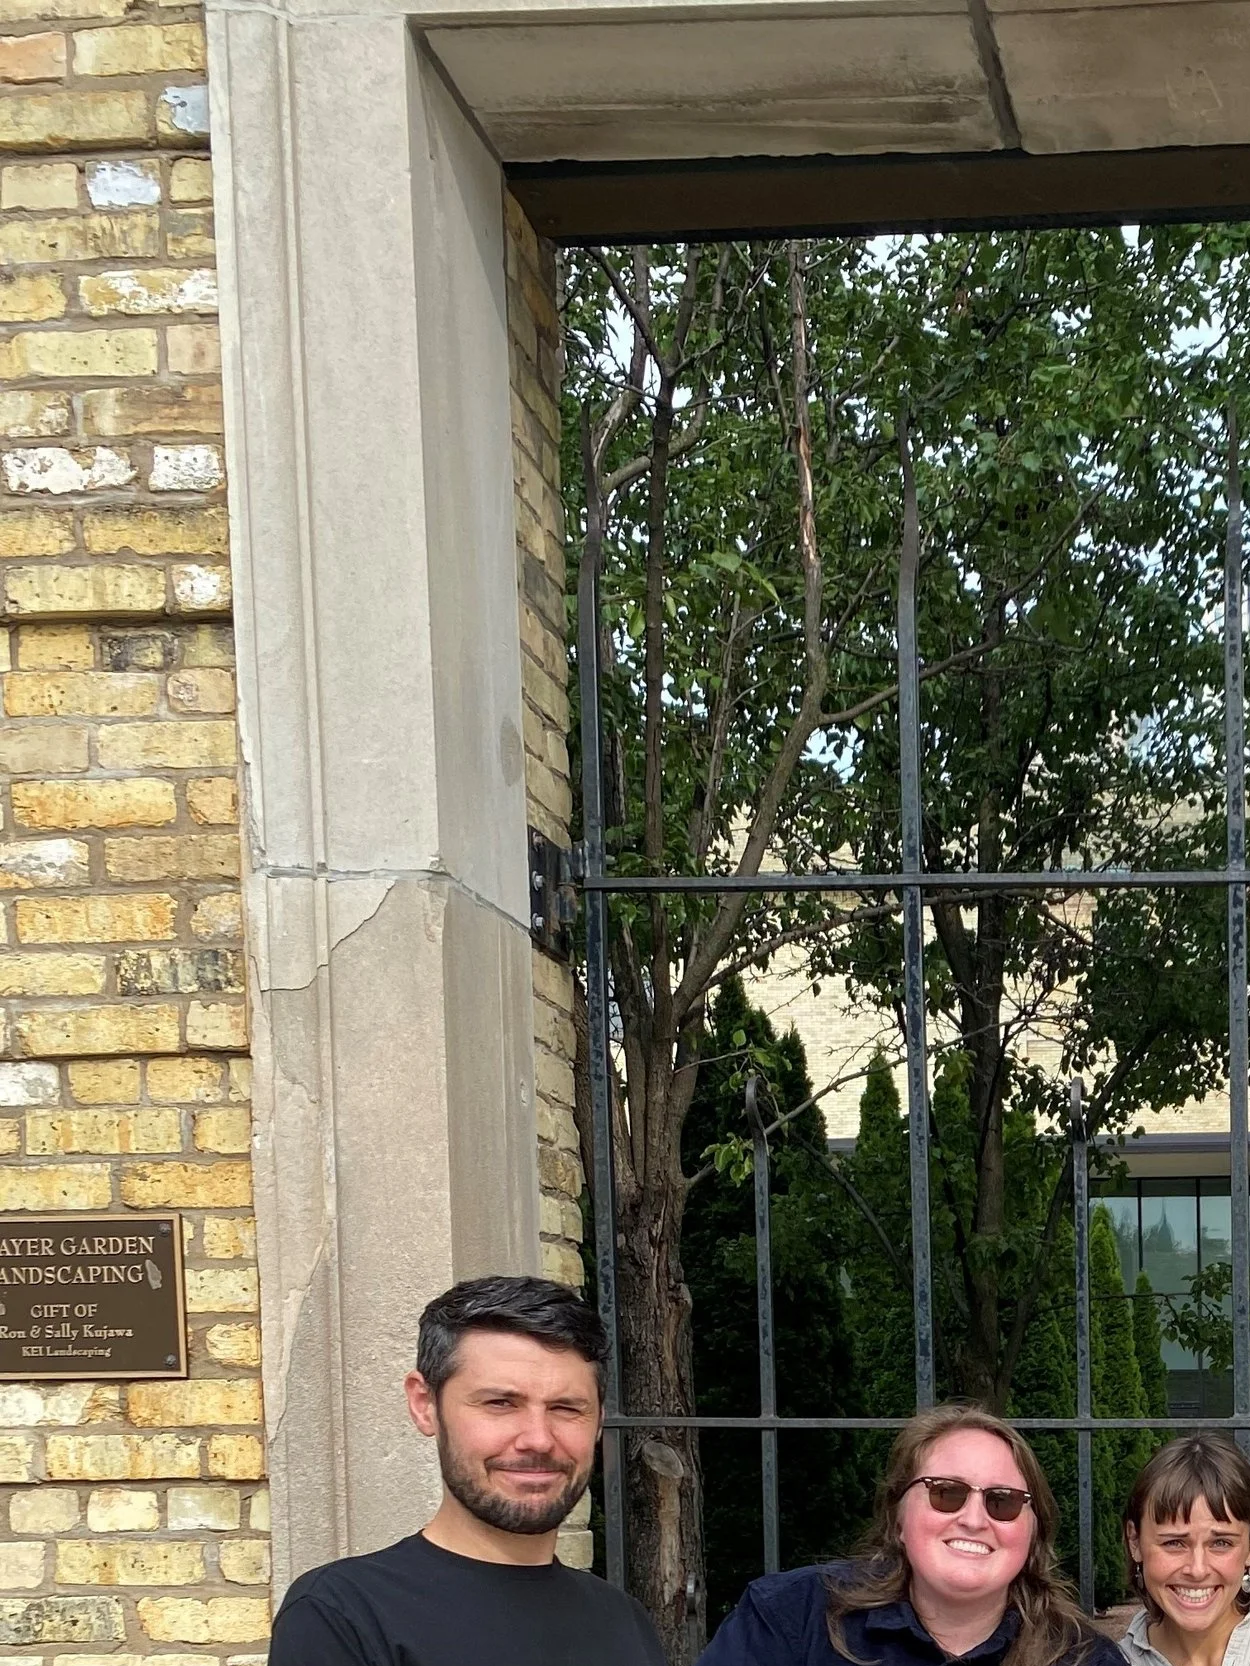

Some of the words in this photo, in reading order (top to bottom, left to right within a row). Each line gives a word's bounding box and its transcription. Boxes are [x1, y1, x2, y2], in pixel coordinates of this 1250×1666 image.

[59, 1236, 155, 1256] GARDEN
[30, 1303, 71, 1318] GIFT
[74, 1303, 98, 1318] OF
[0, 1325, 27, 1339] Ron
[30, 1325, 41, 1339] &
[45, 1322, 79, 1341] Sally
[82, 1323, 134, 1340] Kujawa
[22, 1345, 44, 1357] KEI
[46, 1344, 112, 1358] Landscaping
